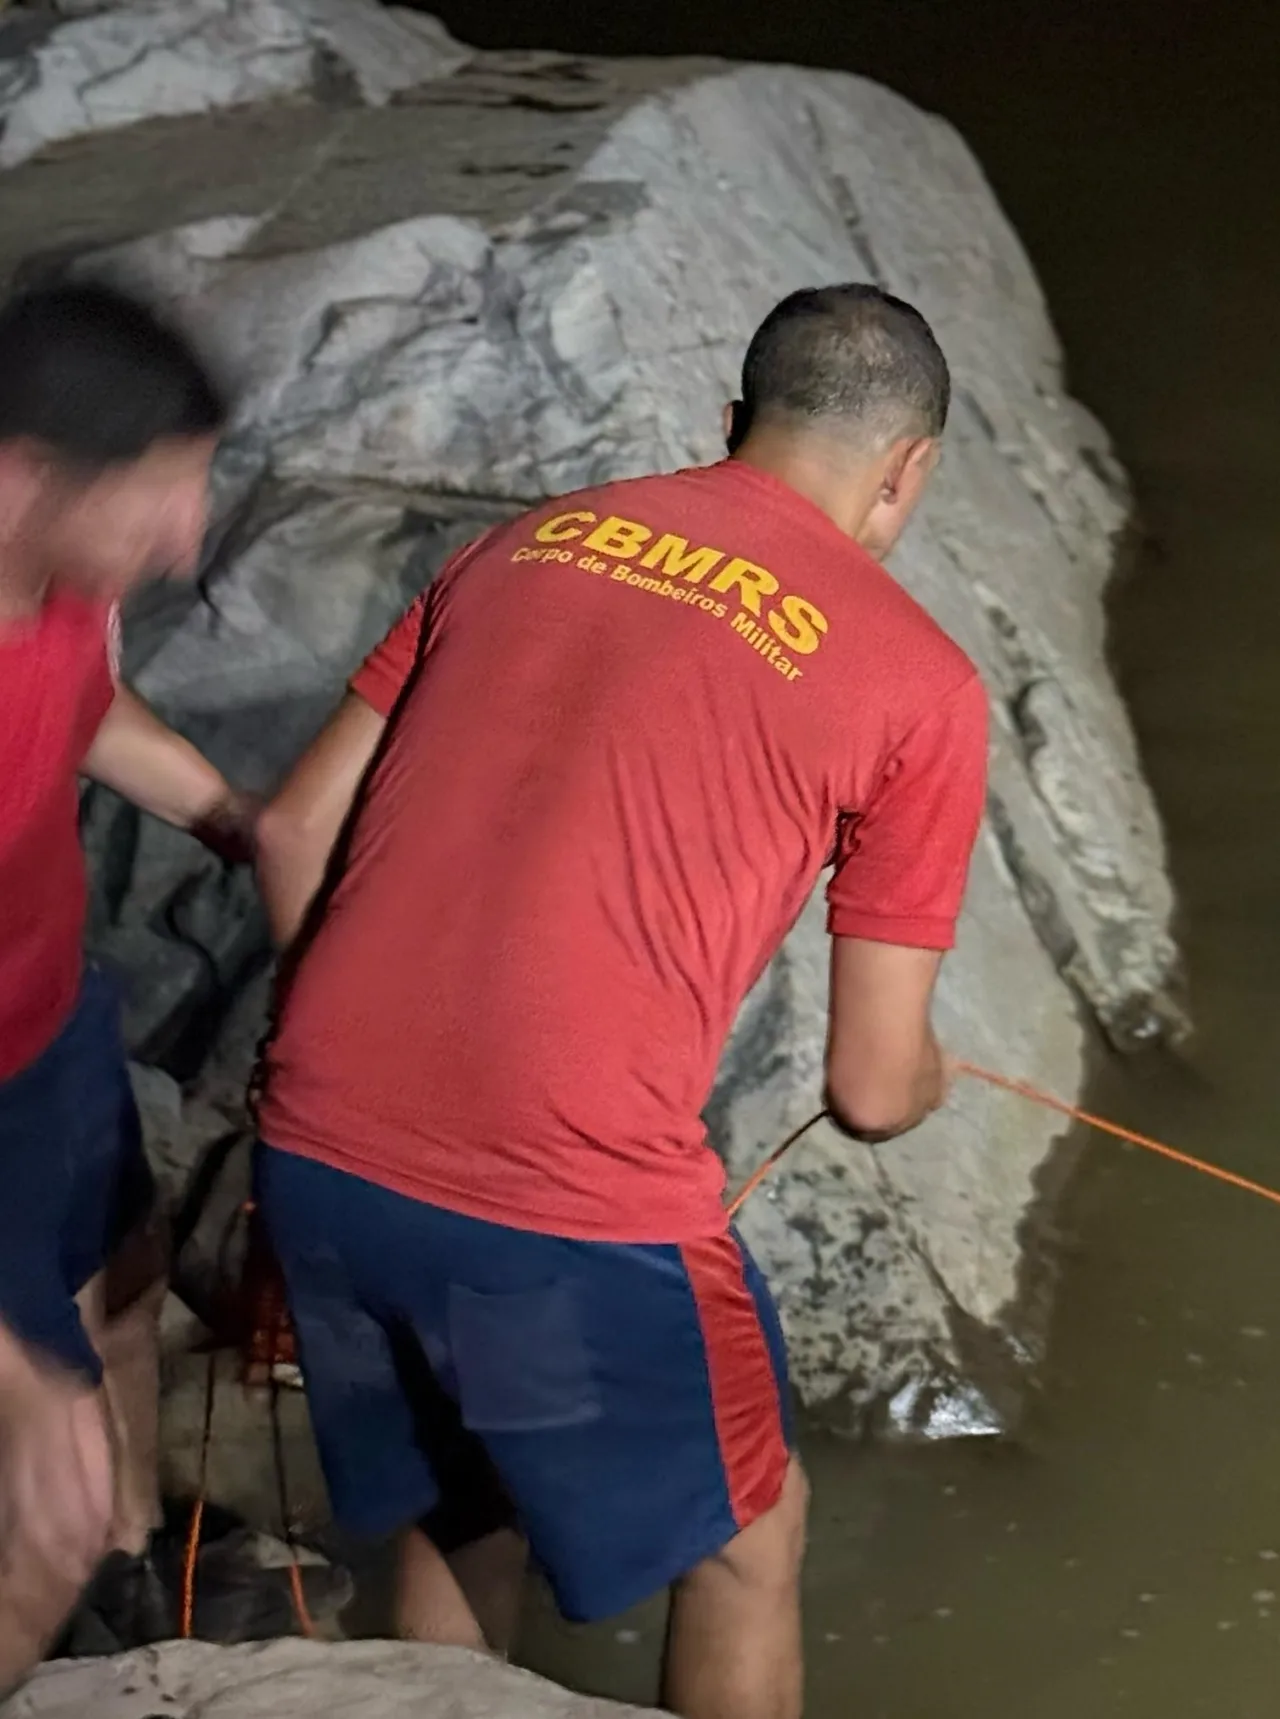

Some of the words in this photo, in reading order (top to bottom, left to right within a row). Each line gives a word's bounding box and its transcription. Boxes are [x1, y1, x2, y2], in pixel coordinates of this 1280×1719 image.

[535, 511, 828, 655] CBMRS
[577, 554, 608, 575] de
[611, 565, 728, 618] Bombeiros
[730, 611, 803, 681] Militar
